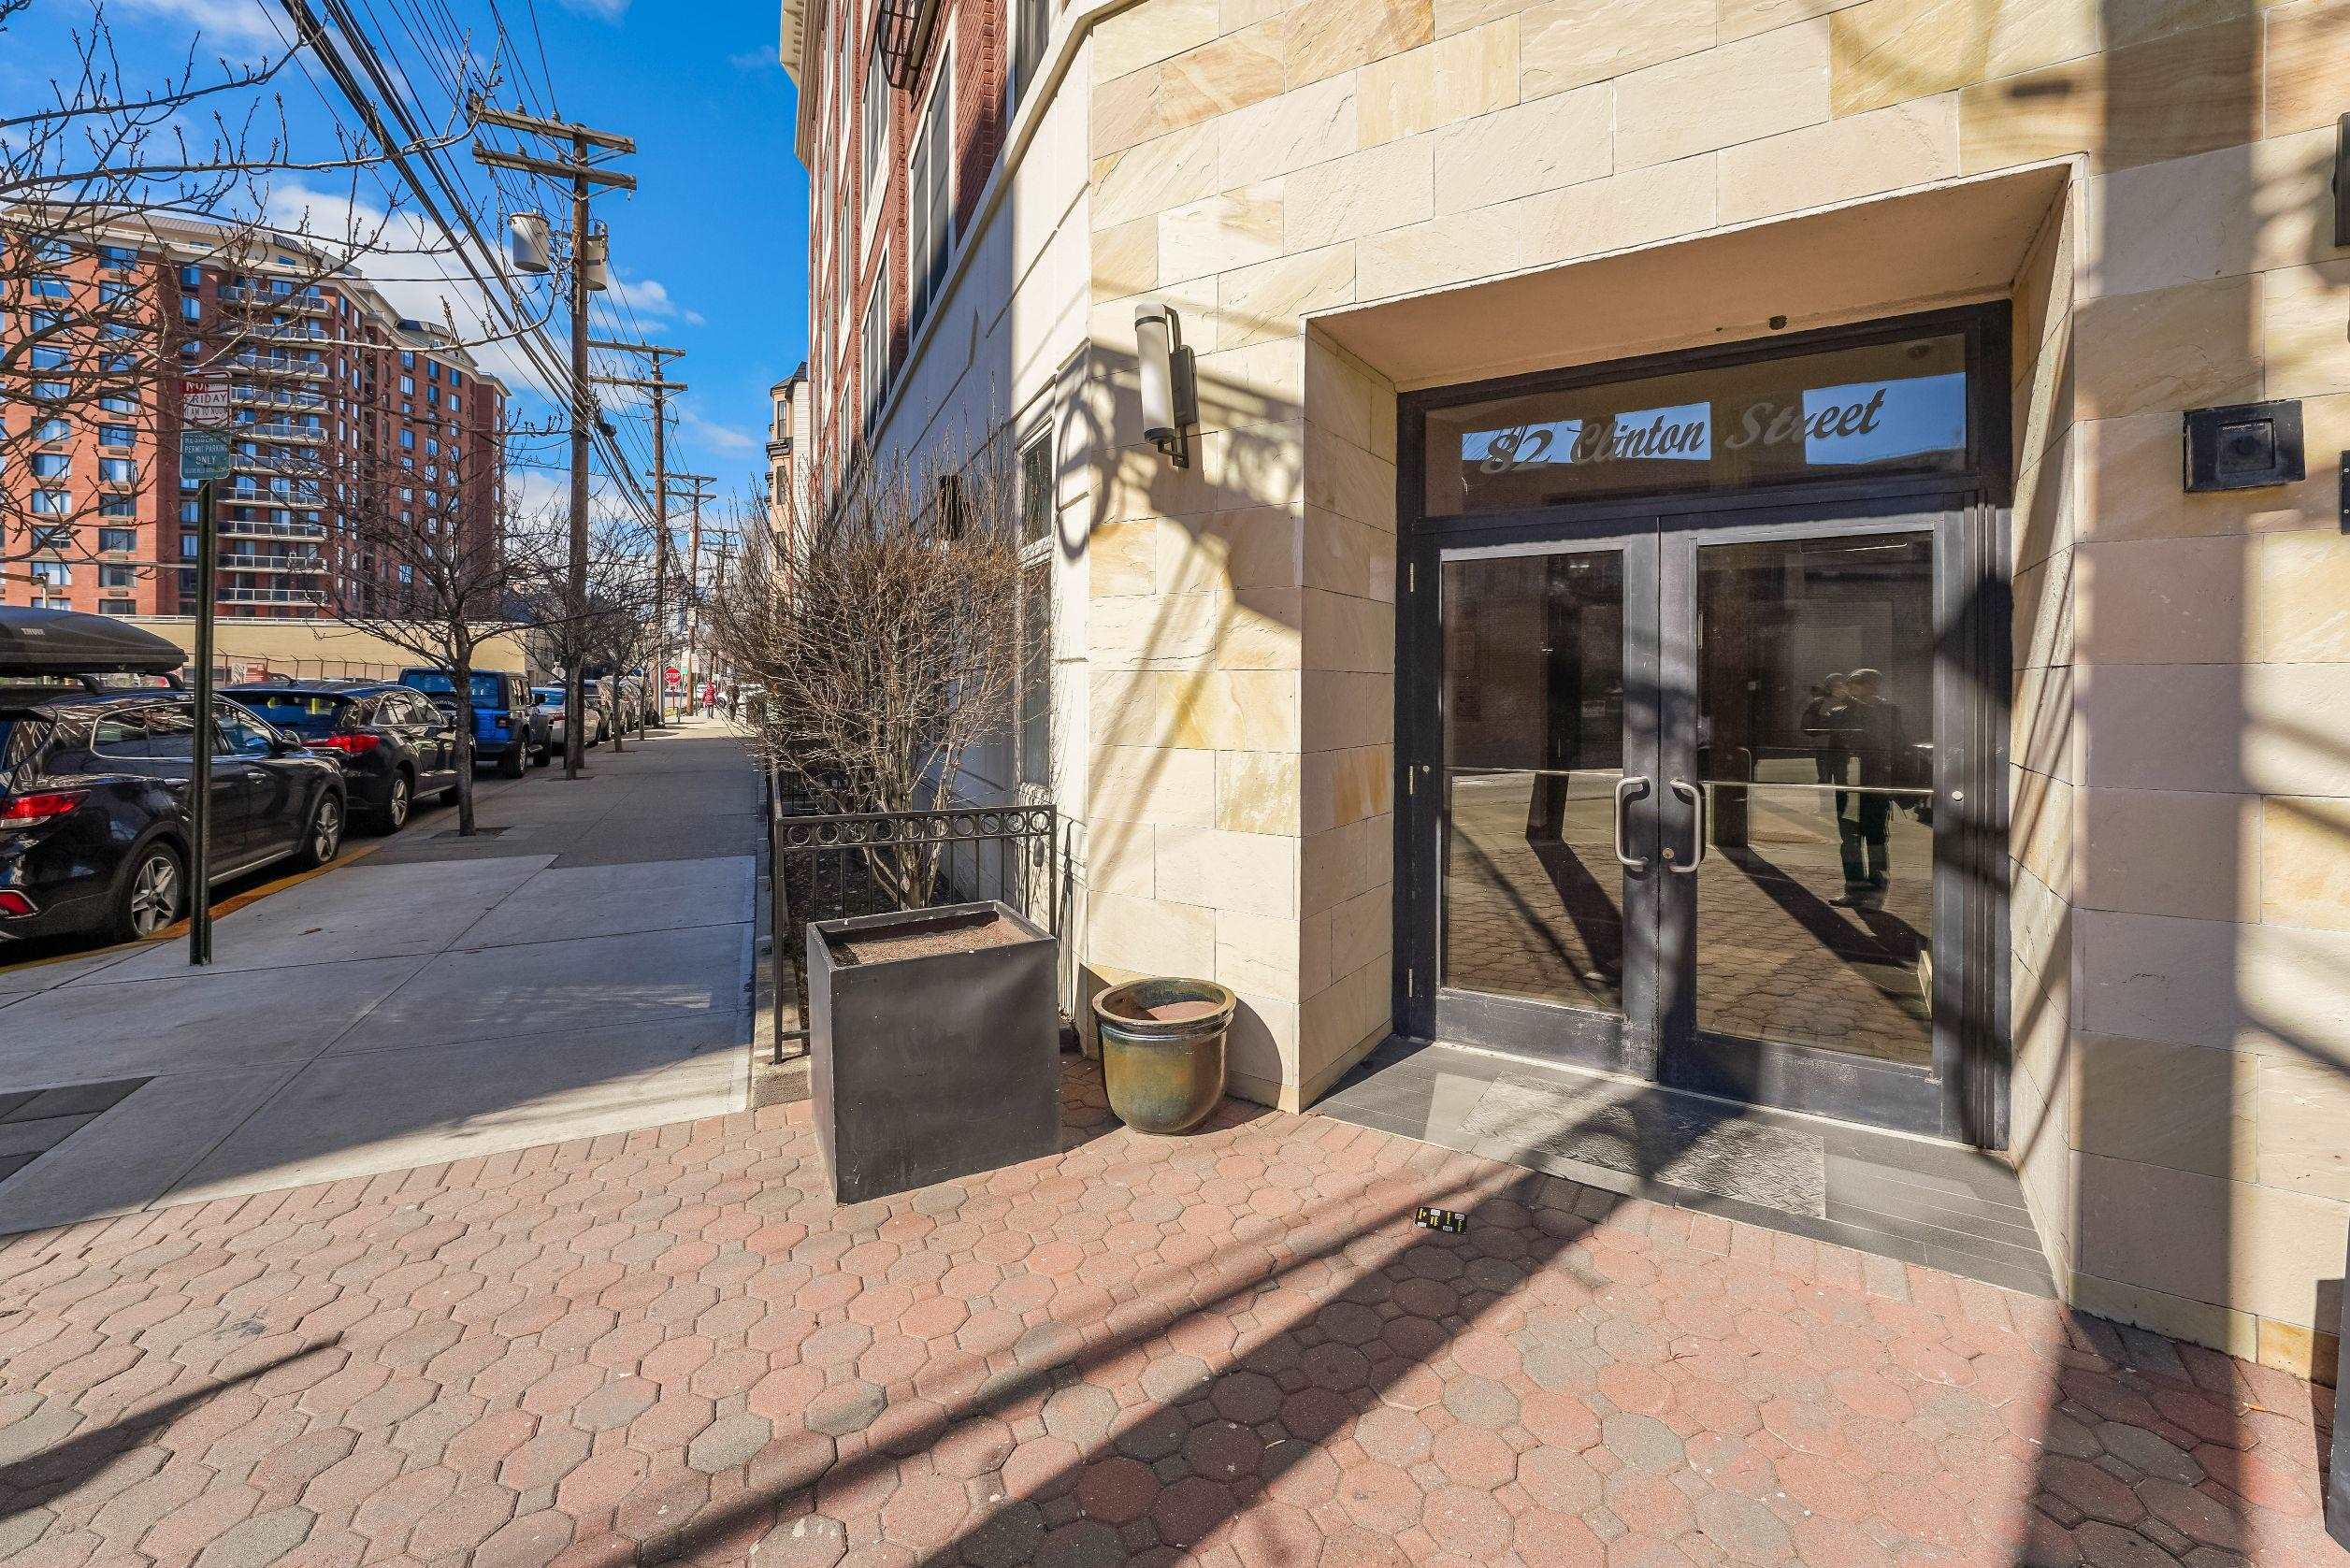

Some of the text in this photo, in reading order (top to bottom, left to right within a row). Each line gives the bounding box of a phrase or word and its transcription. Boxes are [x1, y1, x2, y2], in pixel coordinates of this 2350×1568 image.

[183, 393, 227, 404] FRIDAY
[1479, 388, 1887, 474] 82 Clinton Street
[195, 454, 216, 466] ONLY
